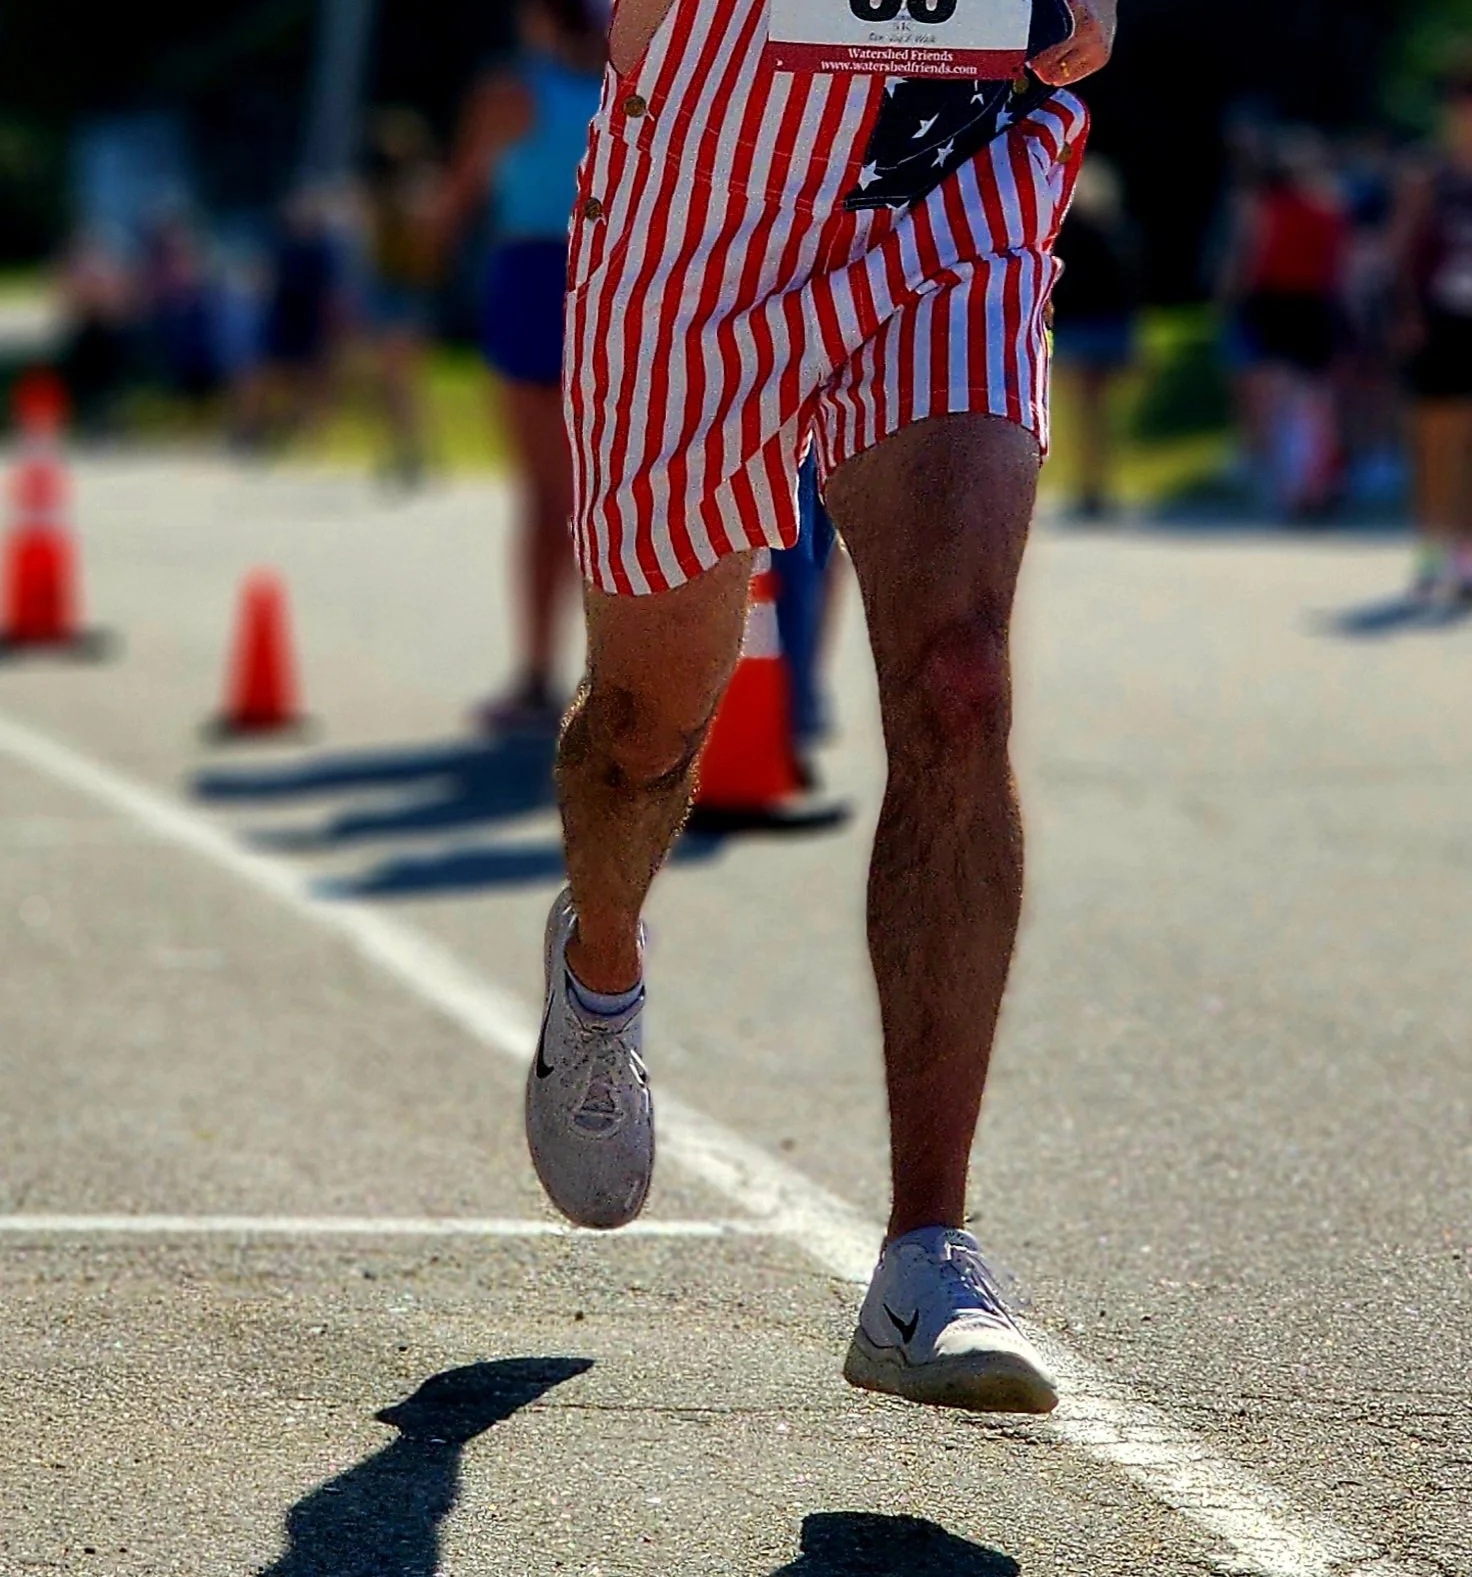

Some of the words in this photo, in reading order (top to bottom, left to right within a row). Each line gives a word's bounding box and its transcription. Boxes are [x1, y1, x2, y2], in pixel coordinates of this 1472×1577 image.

[848, 48, 908, 61] Watershed
[910, 49, 954, 62] Friends
[821, 60, 978, 75] www.watershedfriends.com
